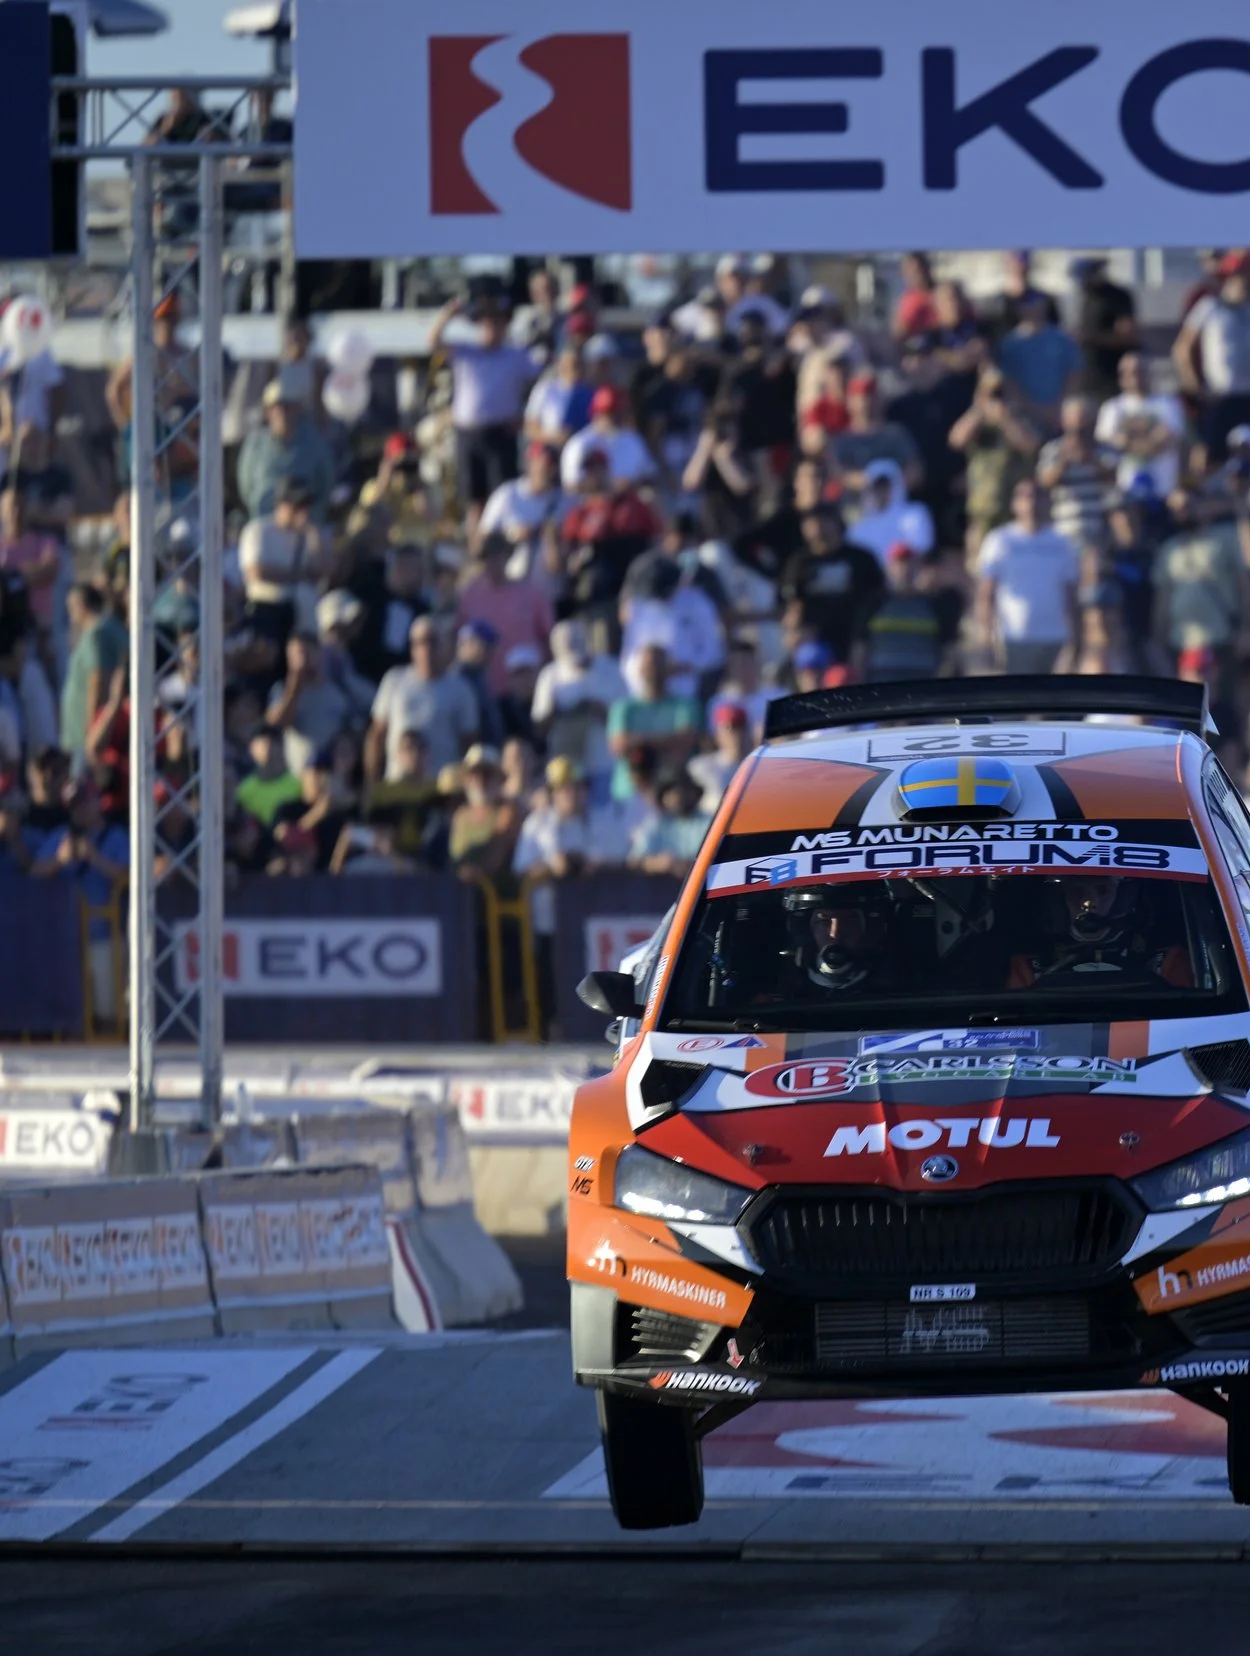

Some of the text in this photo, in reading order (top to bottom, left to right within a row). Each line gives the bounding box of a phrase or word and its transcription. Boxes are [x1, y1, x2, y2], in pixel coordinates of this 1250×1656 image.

[903, 732, 1030, 751] 32
[790, 823, 1120, 851] MS MUNARETTO
[811, 843, 1170, 874] FORUM8
[876, 866, 1036, 878] フォーラムエイト
[258, 933, 428, 980] EKO
[853, 1054, 1137, 1081] CARLSSON
[497, 1088, 570, 1120] EK
[16, 1116, 95, 1156] EKO
[823, 1116, 1061, 1157] MOTUL
[631, 1265, 727, 1309] HYRMASKINER
